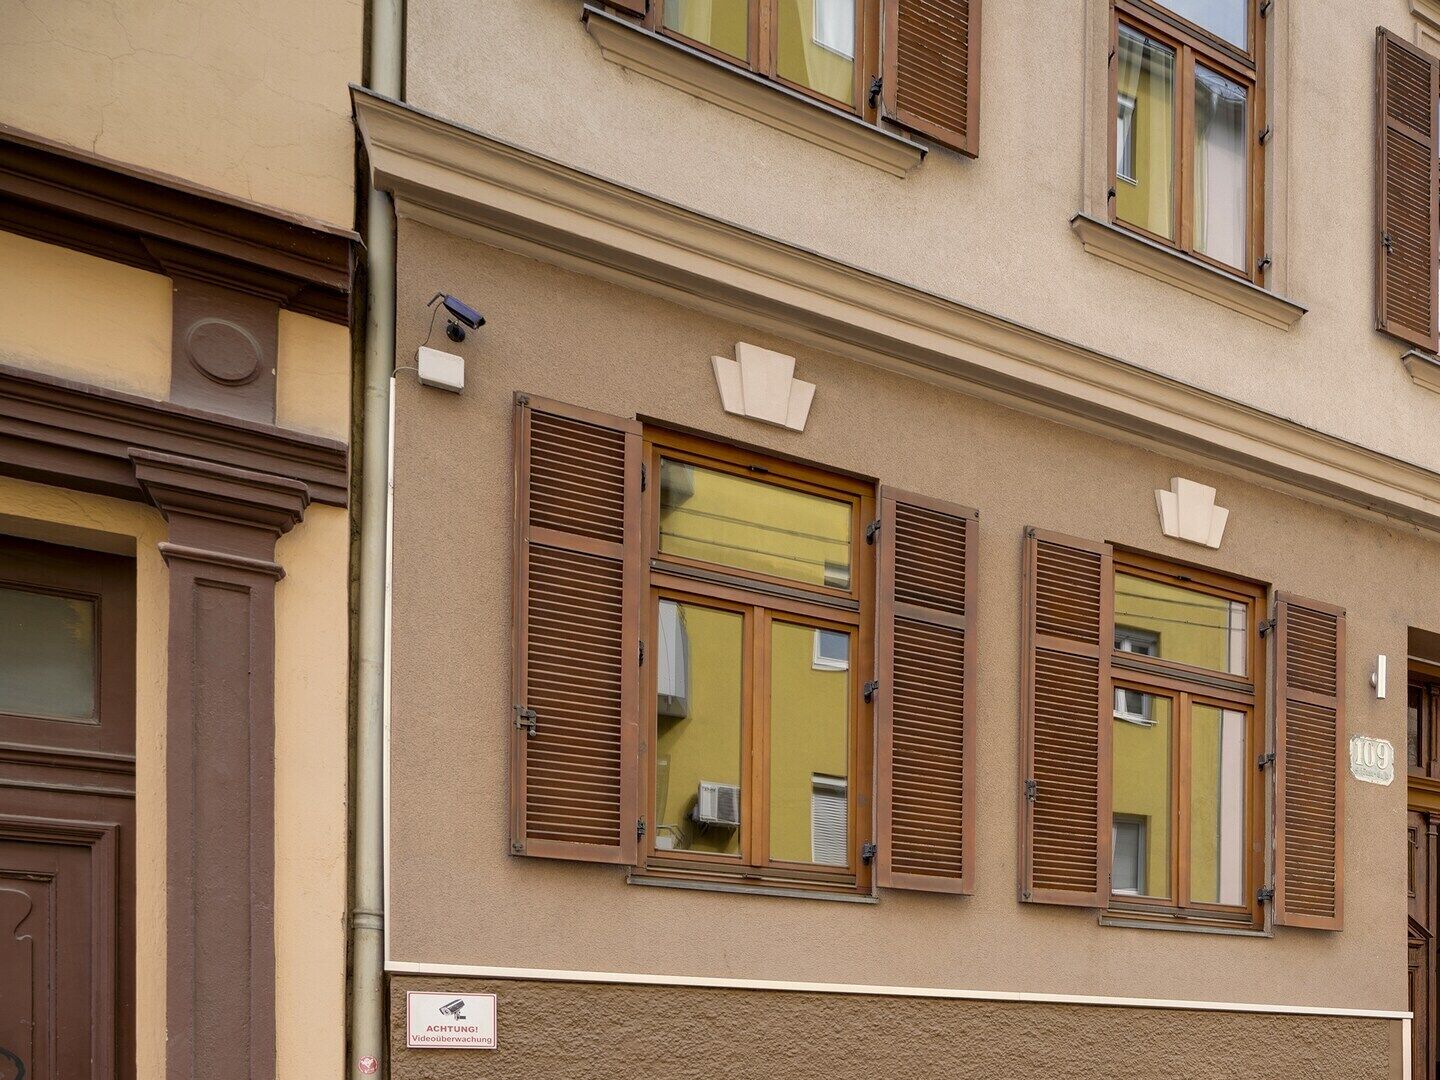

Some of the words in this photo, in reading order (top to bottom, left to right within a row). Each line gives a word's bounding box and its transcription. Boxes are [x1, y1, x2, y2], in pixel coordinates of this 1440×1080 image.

[1355, 739, 1390, 770] 109
[426, 1025, 478, 1033] ACHTUNG!
[411, 1034, 492, 1044] Videoüberwachung
